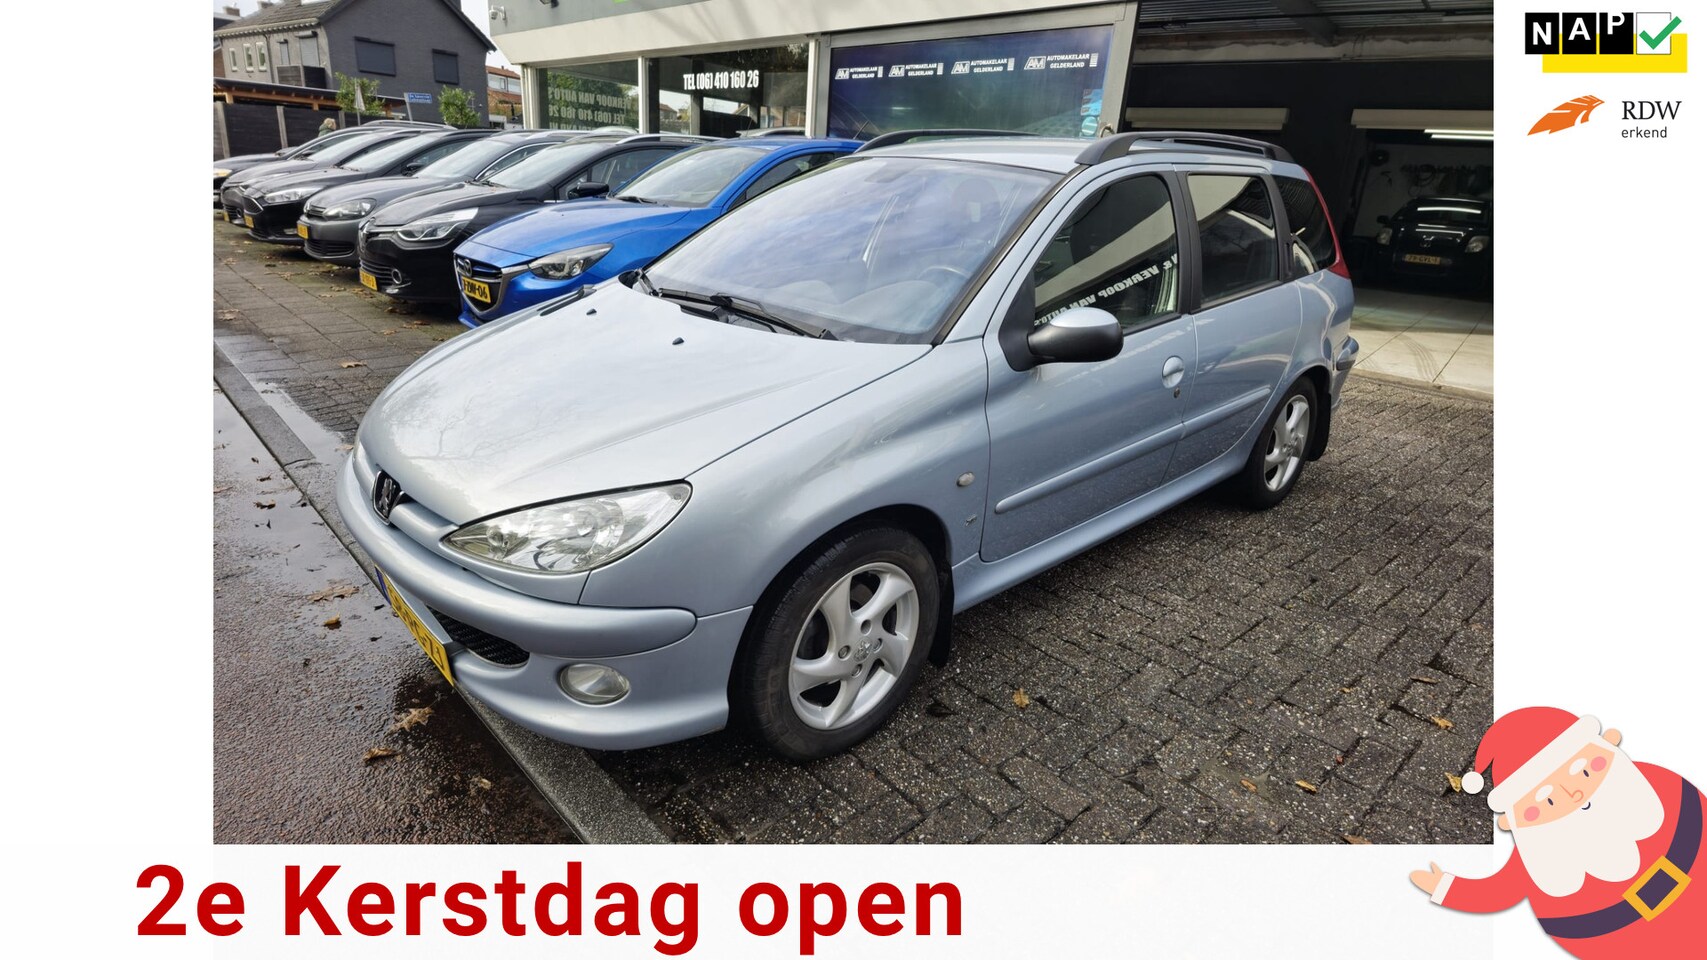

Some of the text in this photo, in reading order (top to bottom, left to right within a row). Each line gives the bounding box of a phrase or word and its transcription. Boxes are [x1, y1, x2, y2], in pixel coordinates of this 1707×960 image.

[970, 58, 1008, 66] AUTOMAKELAAR
[683, 70, 759, 90] TEL (06) 410 160 26
